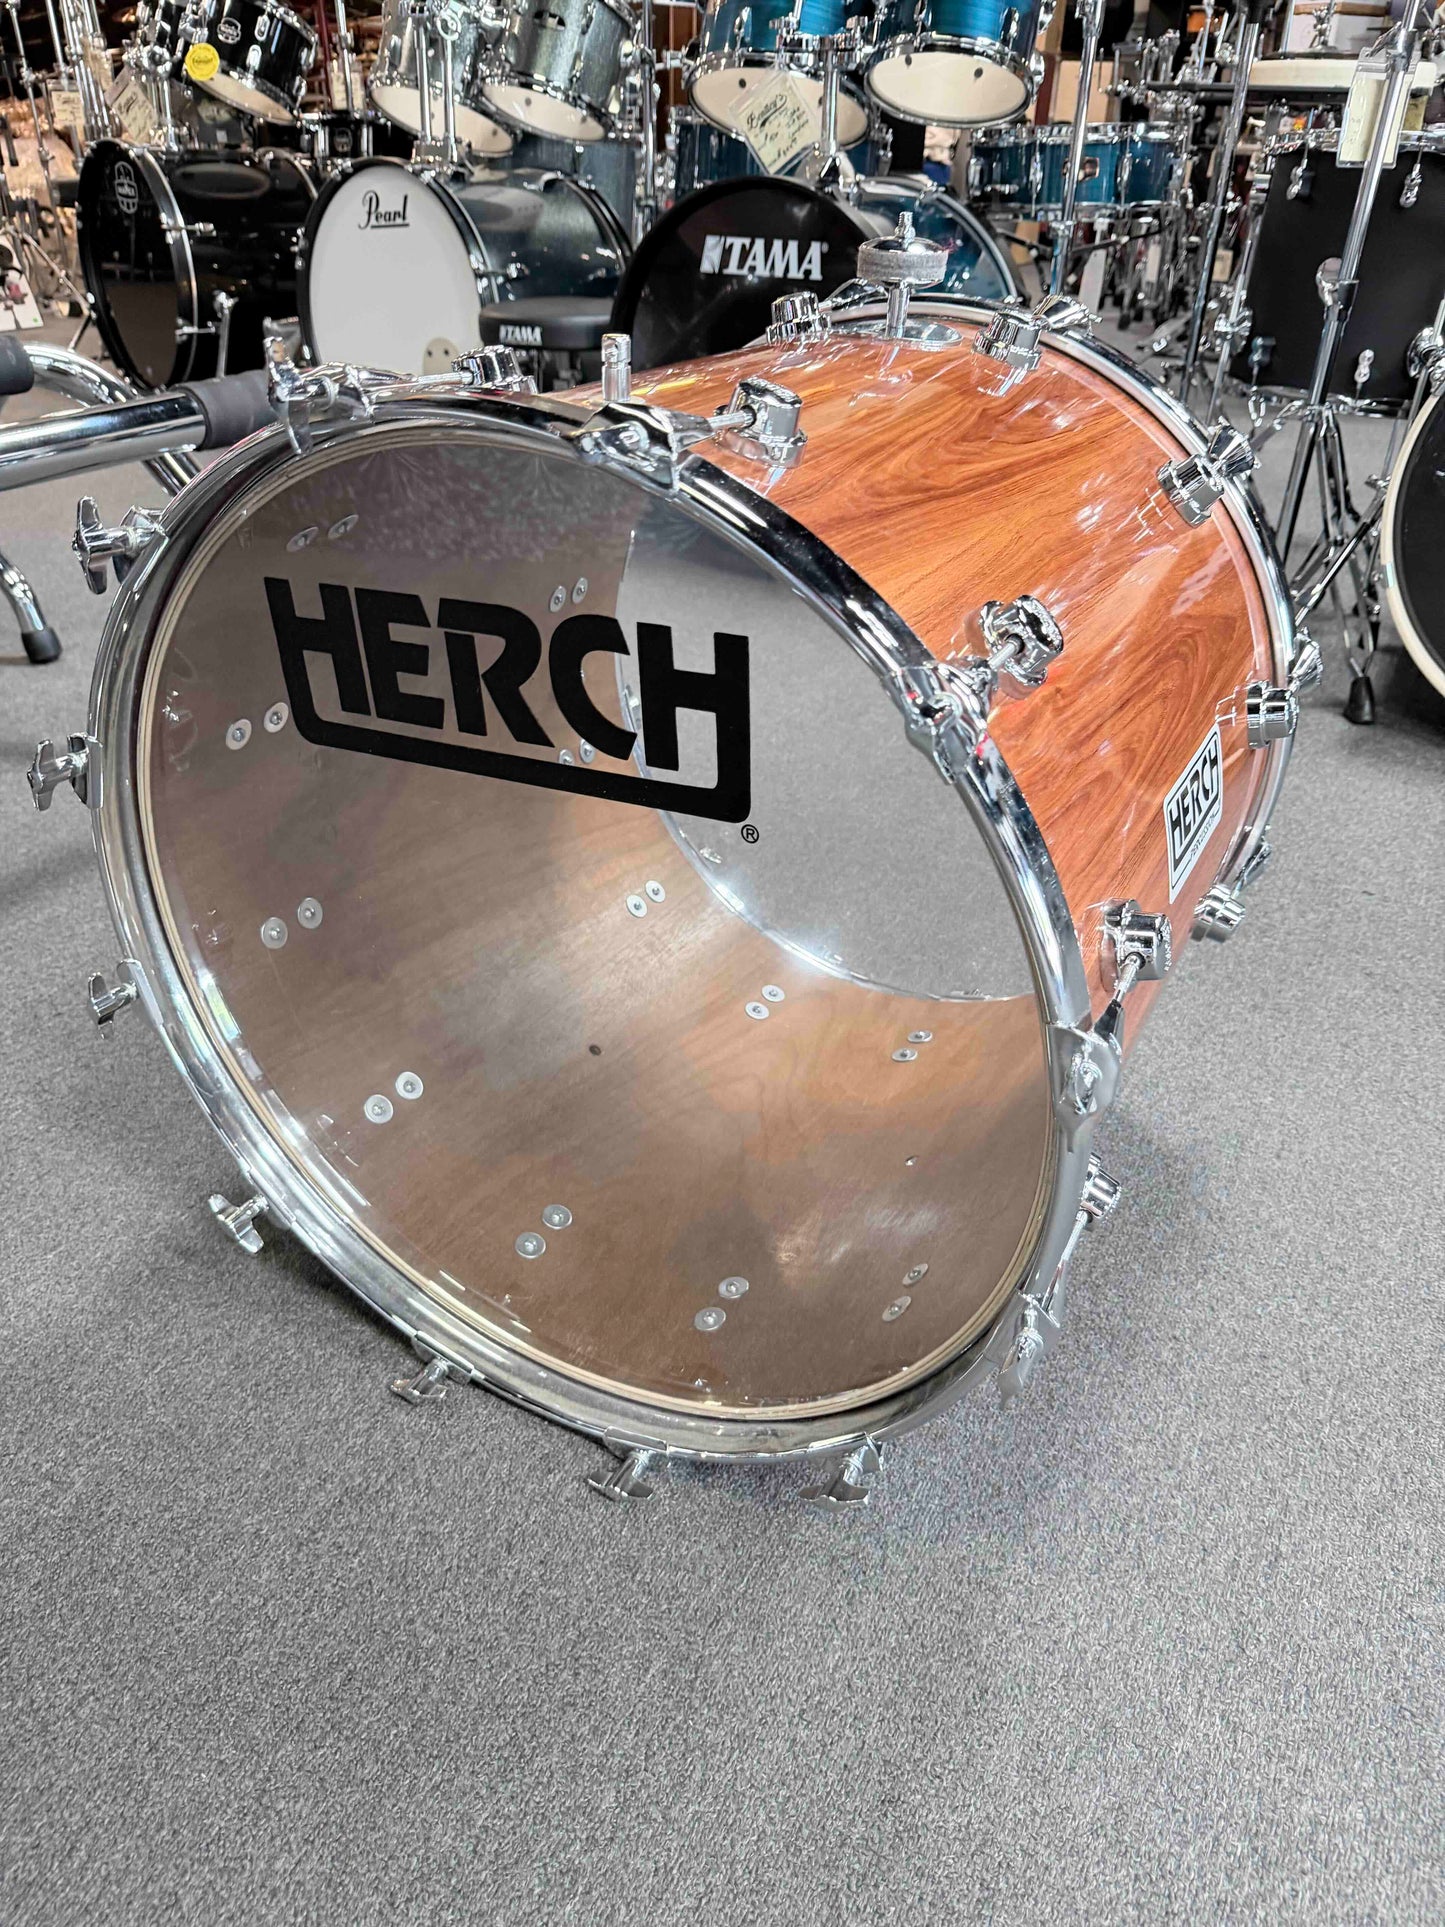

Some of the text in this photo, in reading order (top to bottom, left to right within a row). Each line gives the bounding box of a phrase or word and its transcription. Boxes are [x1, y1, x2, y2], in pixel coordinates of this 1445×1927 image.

[358, 190, 408, 229] Pearl
[723, 236, 823, 280] TAMA
[507, 325, 542, 346] TAMA
[264, 577, 752, 824] HERCH
[1169, 738, 1219, 872] HERCH
